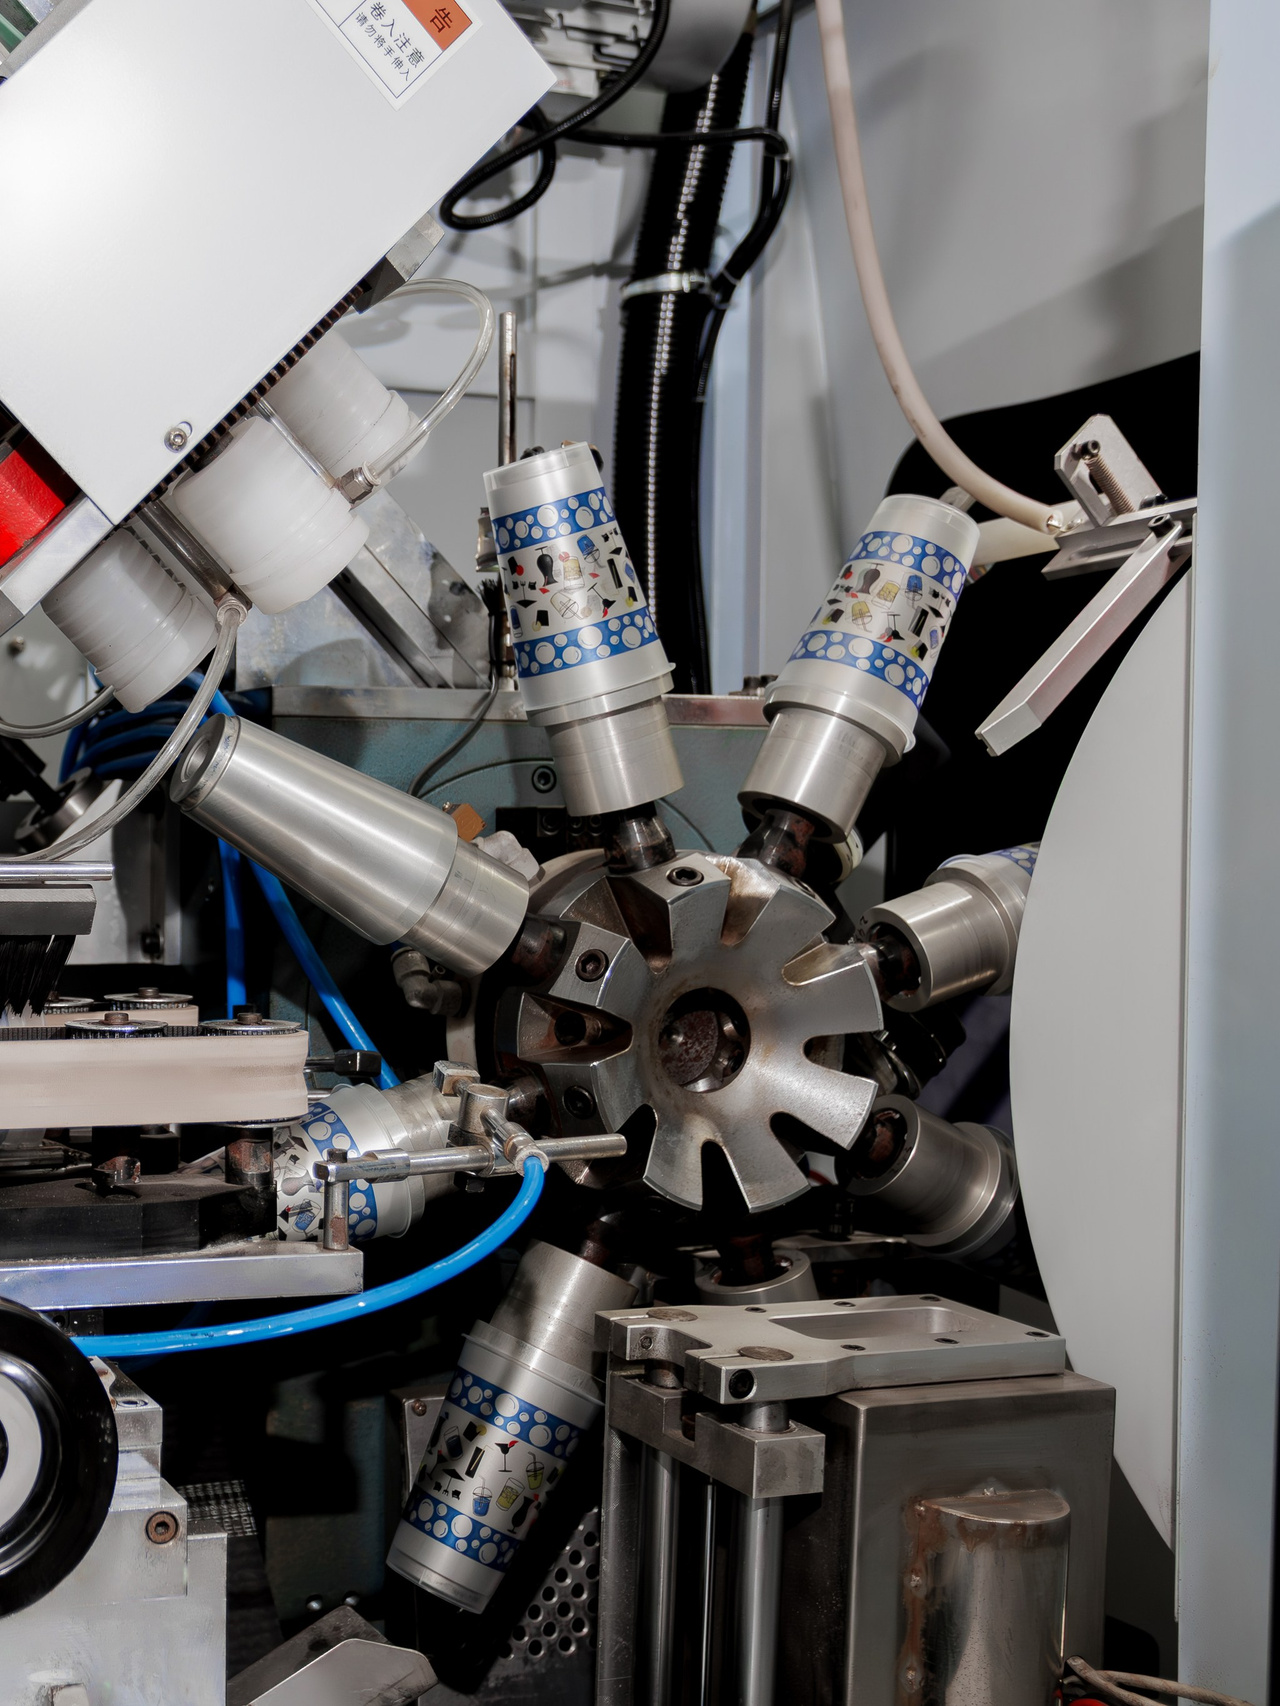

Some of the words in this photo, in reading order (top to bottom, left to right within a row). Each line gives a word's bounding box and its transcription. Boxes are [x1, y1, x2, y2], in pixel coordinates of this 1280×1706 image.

[355, 11, 411, 82] 请勿将手伸入
[370, 1, 425, 68] 卷入注意
[429, 7, 453, 33] 告
